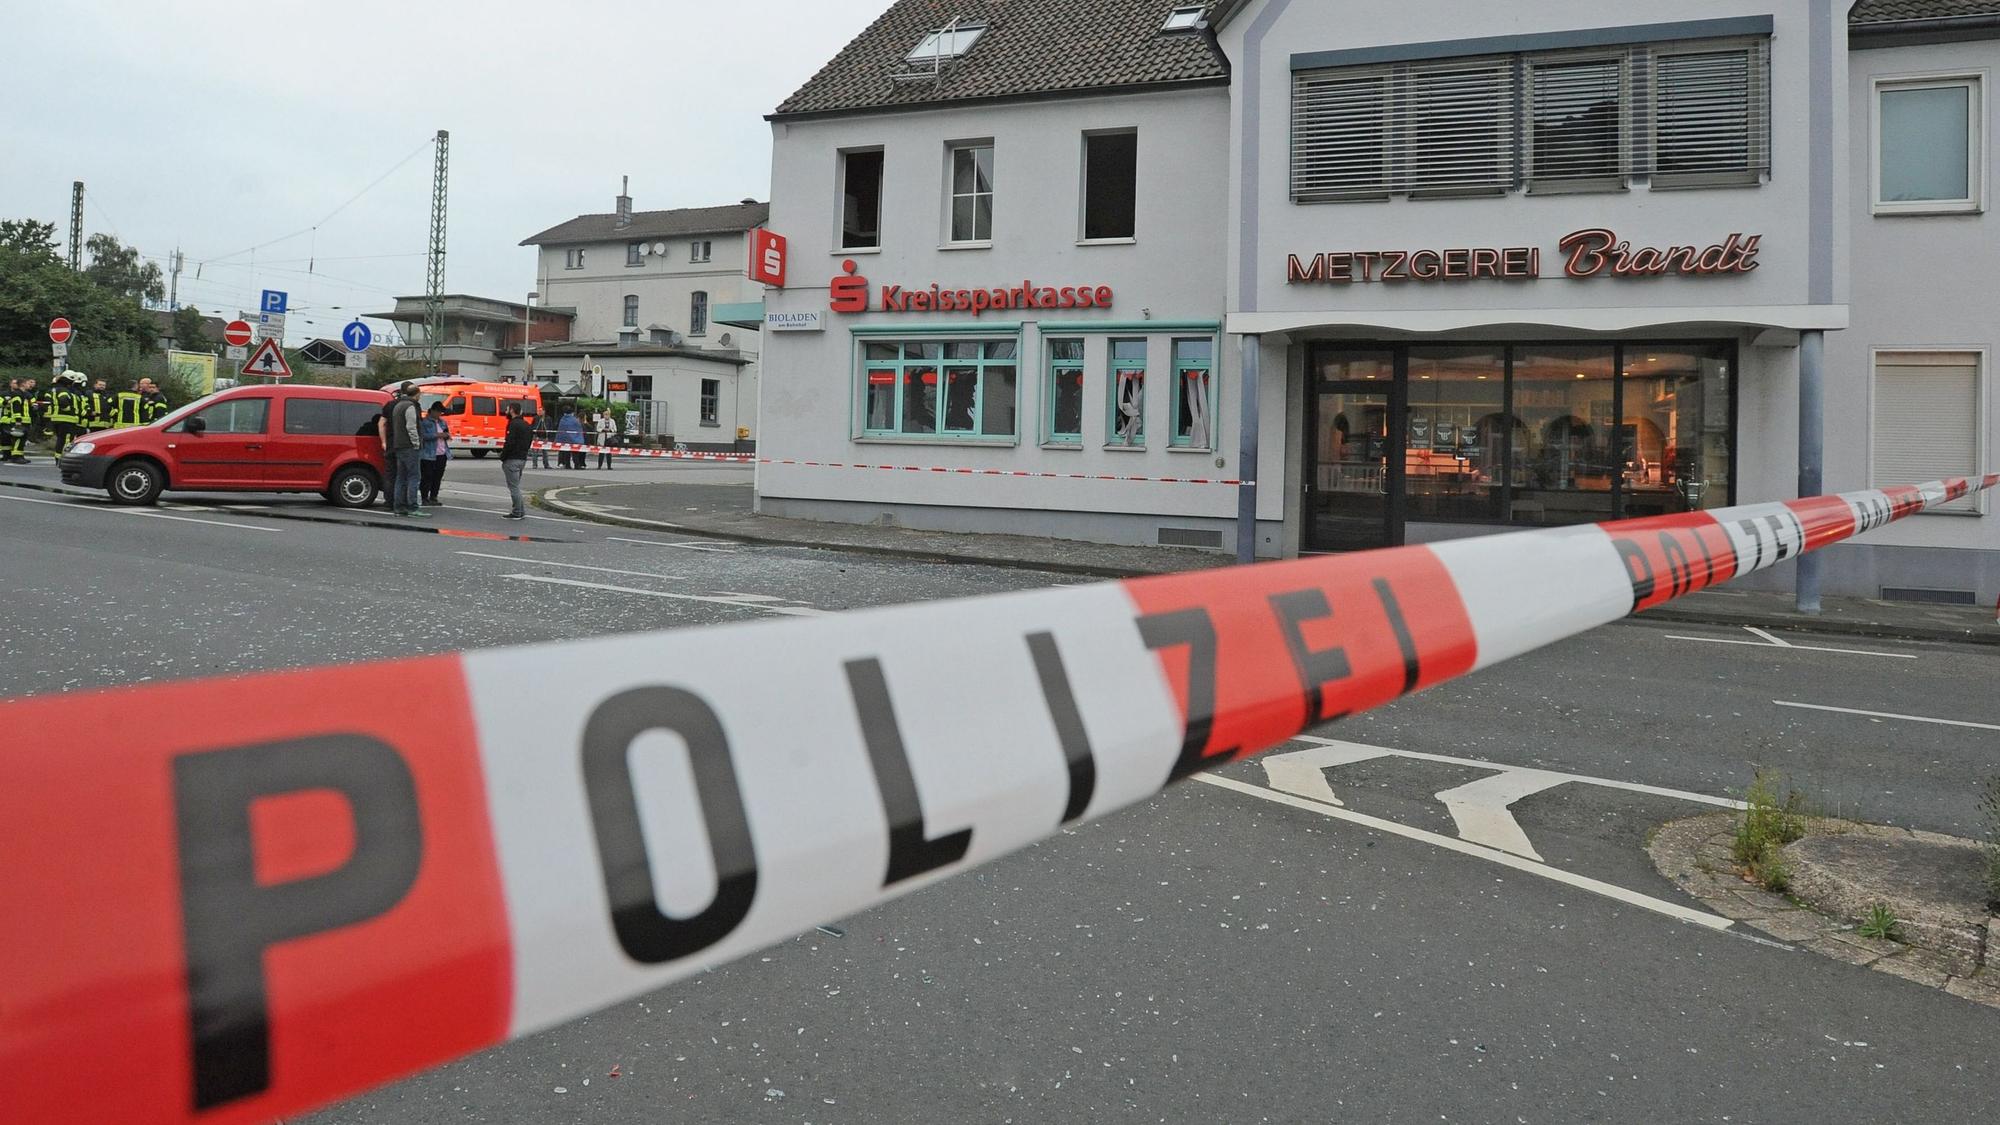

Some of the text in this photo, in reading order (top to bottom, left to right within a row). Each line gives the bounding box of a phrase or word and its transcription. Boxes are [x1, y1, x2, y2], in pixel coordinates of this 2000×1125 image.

[1287, 228, 1763, 282] METZGEREI Brandt
[266, 292, 282, 310] P
[881, 280, 1114, 317] Kreissparkasse
[768, 313, 817, 322] BIOLADEN
[170, 579, 1422, 1112] POLIZEI
